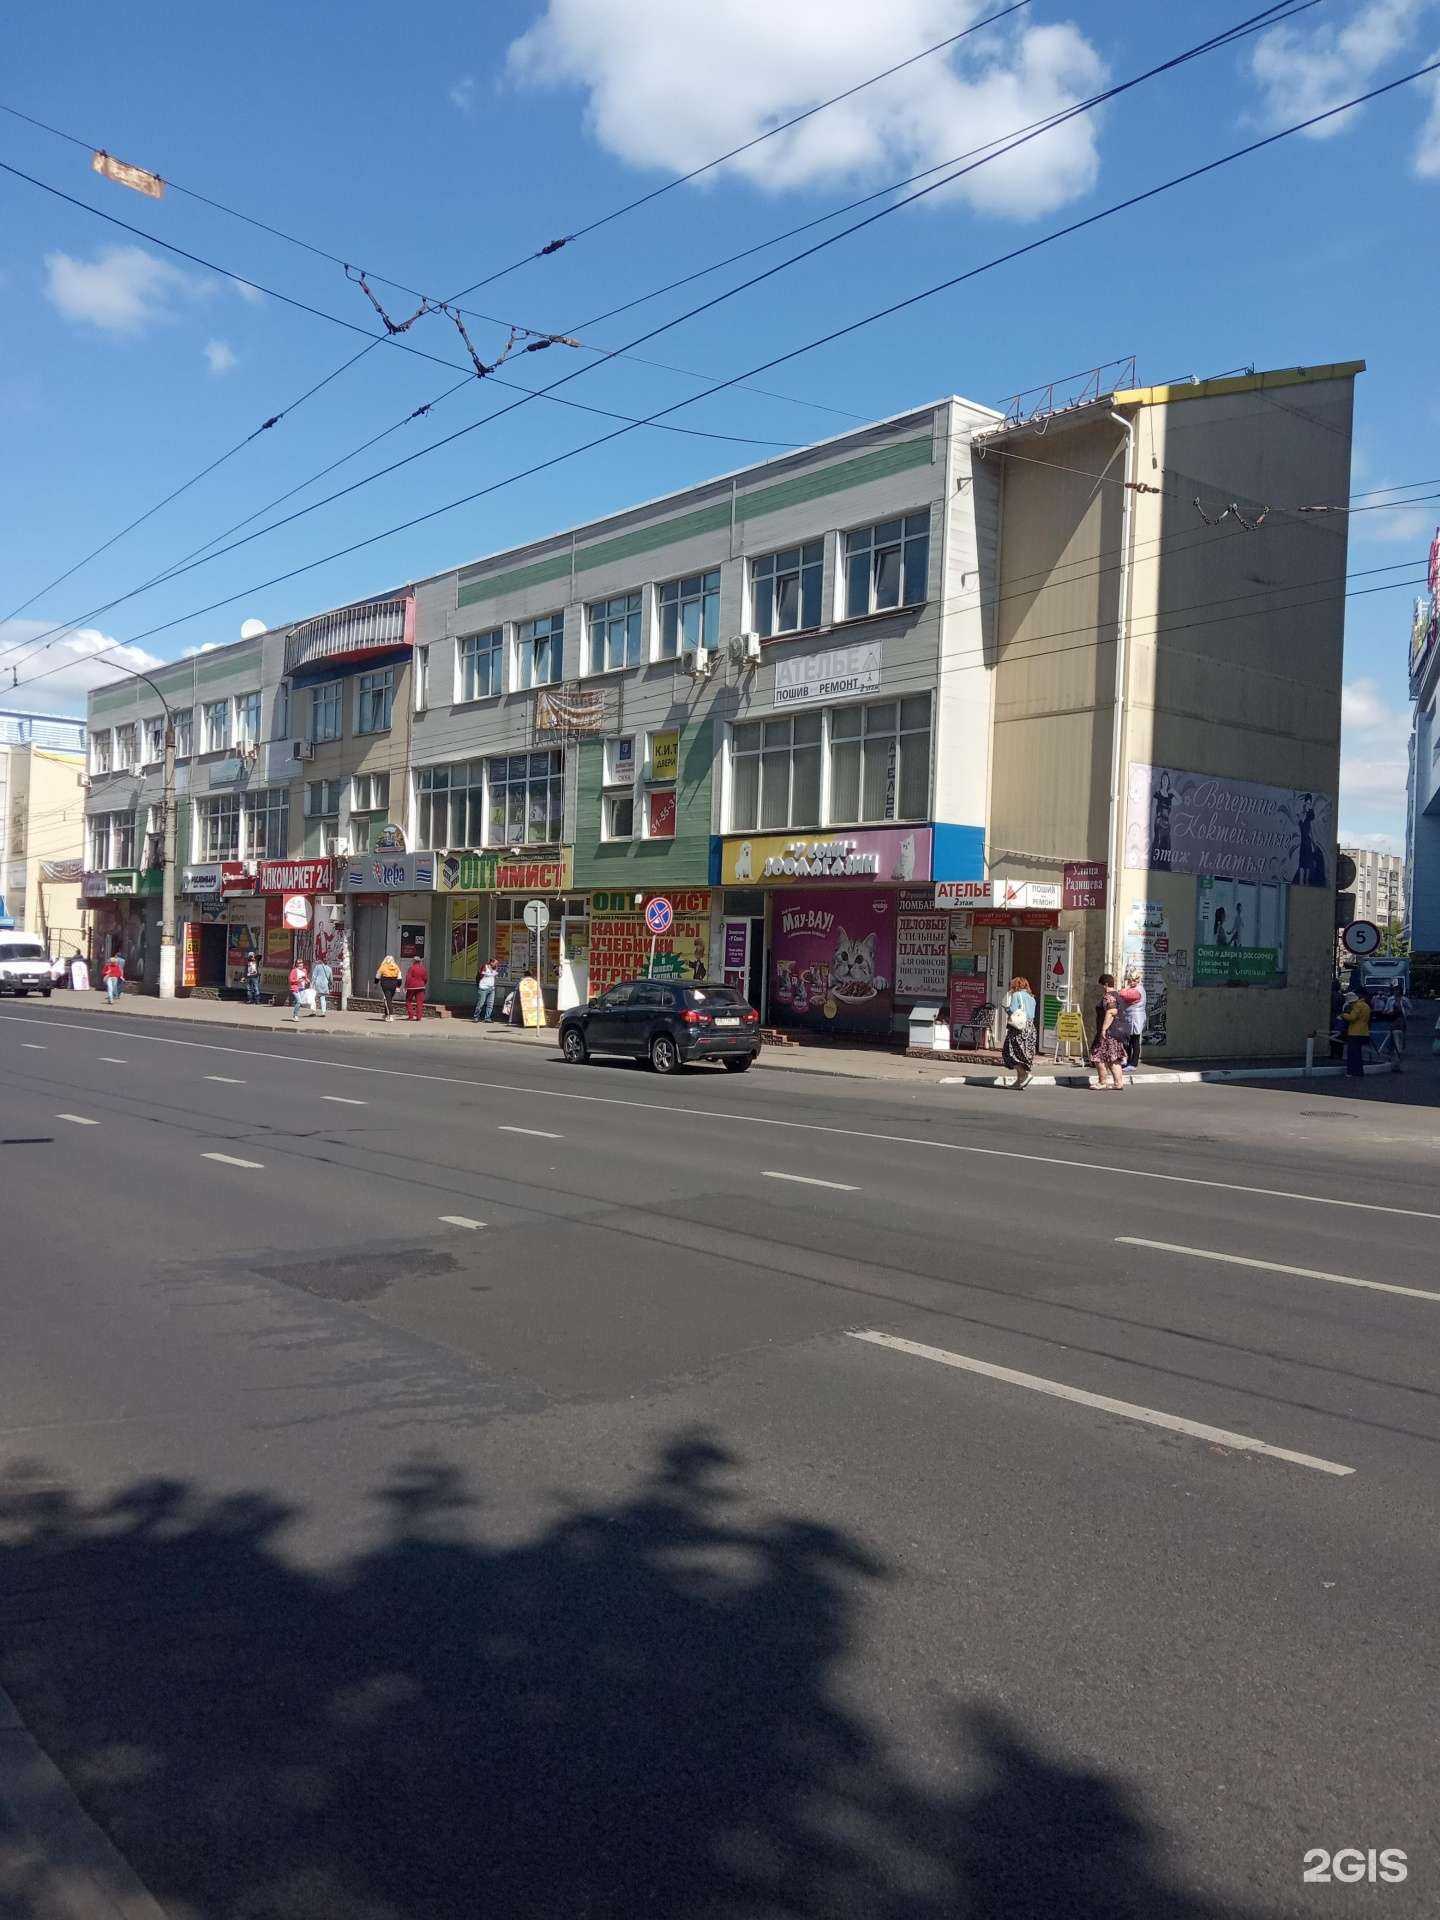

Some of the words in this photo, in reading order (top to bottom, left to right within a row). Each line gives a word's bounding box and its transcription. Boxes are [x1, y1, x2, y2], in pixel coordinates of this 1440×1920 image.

[778, 652, 860, 685] АТЕЛЬЕ
[776, 686, 809, 701] ПОШИВ
[819, 678, 859, 694] РЕМОНТ
[885, 741, 896, 819] АТЕЛЬЕ
[1153, 848, 1190, 864] этаж
[261, 866, 315, 890] АЛКОМАРКЕТ
[316, 864, 329, 888] 24
[1072, 866, 1098, 876] Улица
[938, 883, 991, 898] АТЕЛЬЕ
[899, 900, 935, 910] ЛОМБАР
[1072, 894, 1096, 907] 115а
[899, 918, 947, 930] ДЕЛОВЫЕ
[1356, 931, 1366, 944] 5
[899, 944, 946, 956] ПЛАТЬЯ
[590, 952, 644, 966] КНИГИ
